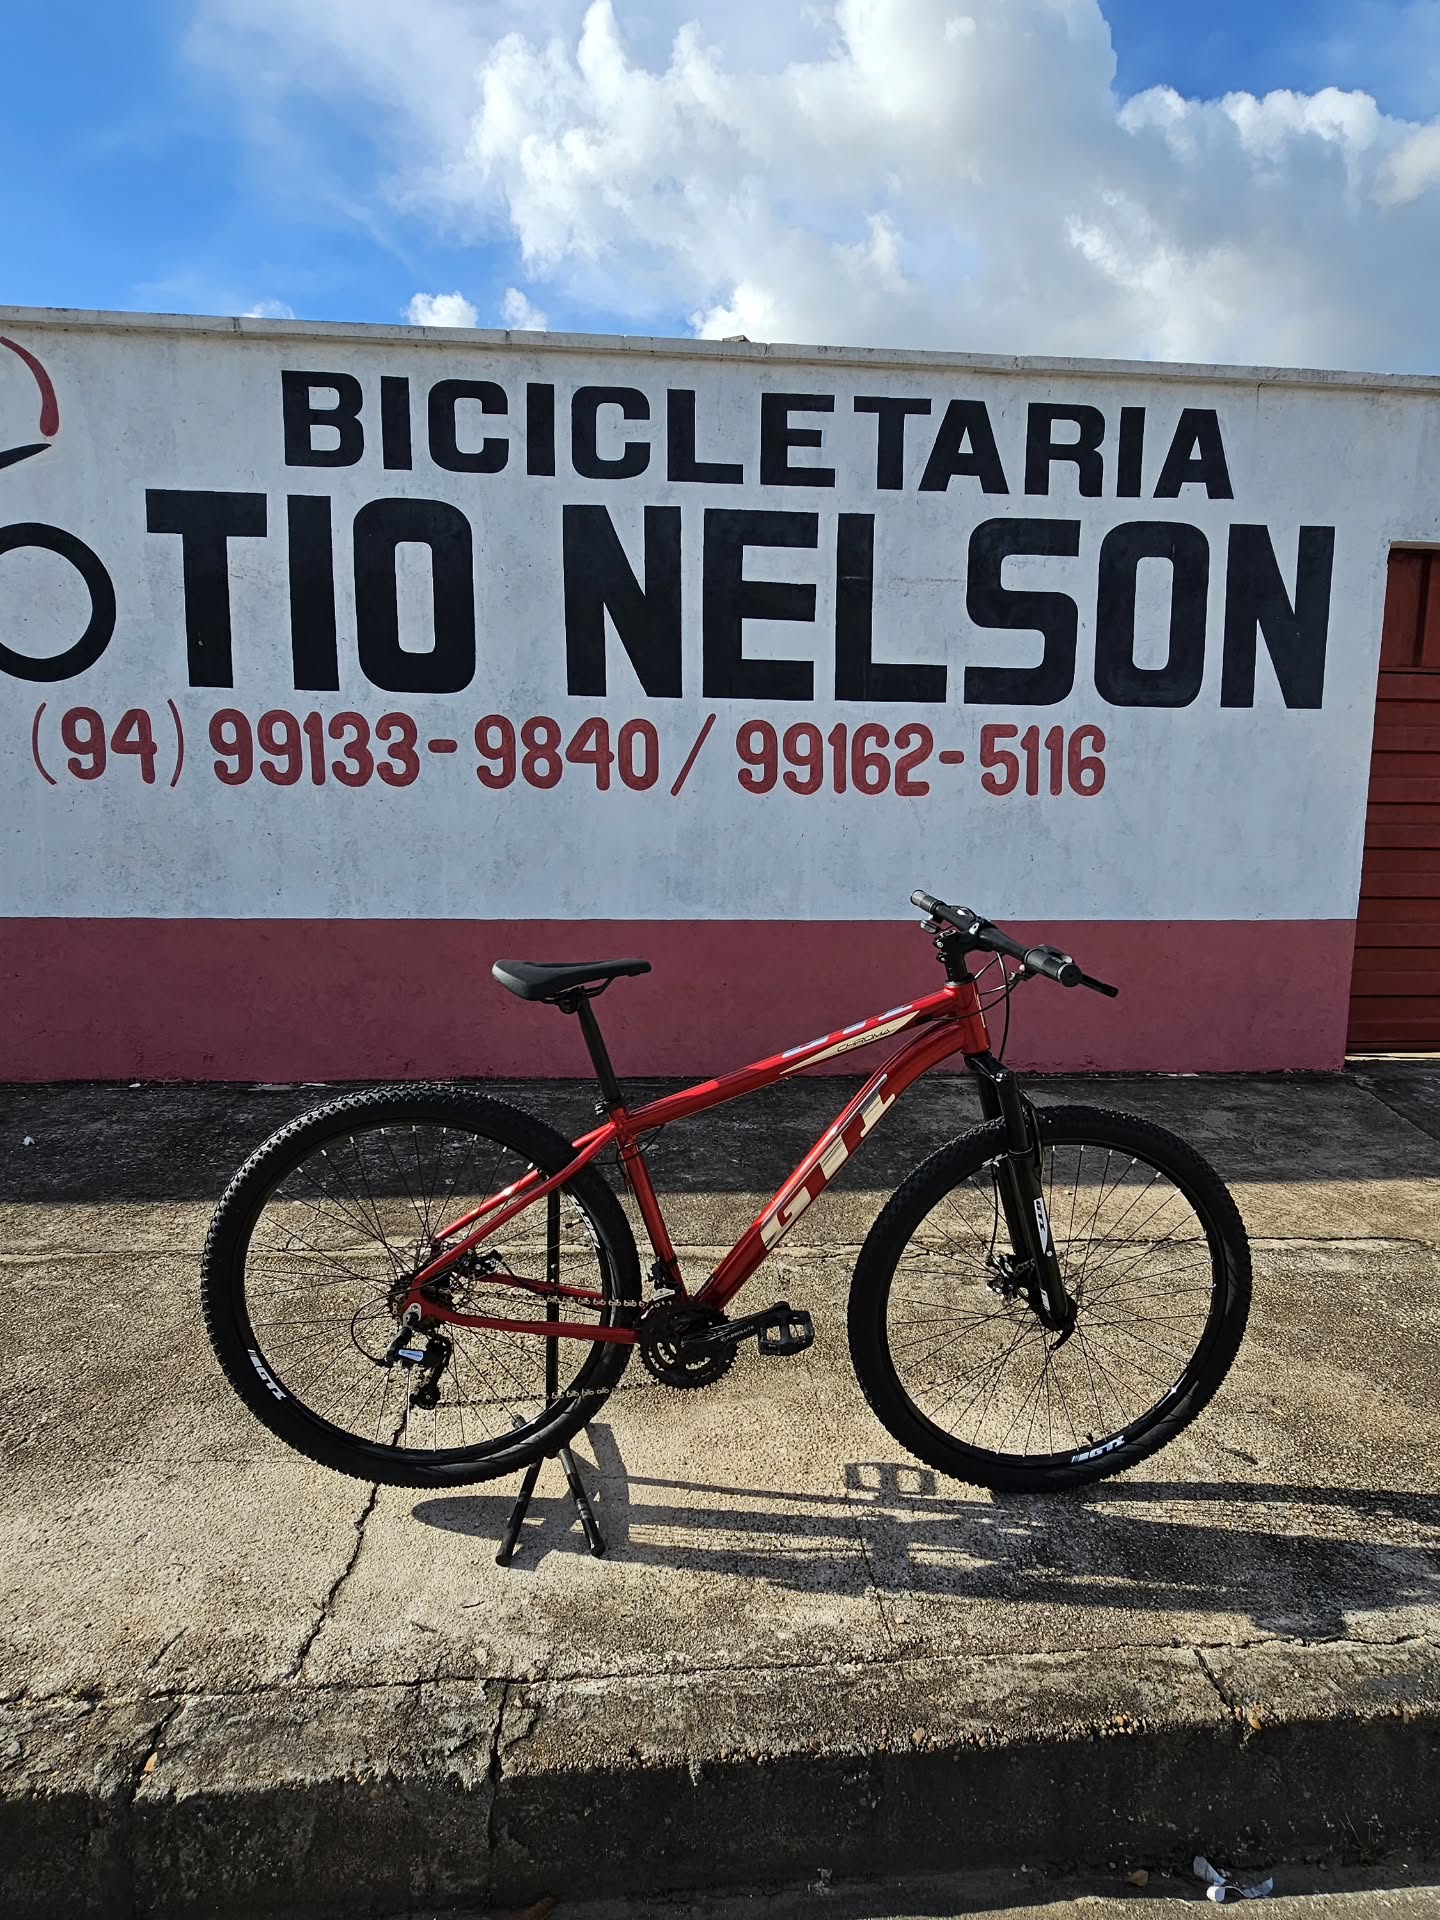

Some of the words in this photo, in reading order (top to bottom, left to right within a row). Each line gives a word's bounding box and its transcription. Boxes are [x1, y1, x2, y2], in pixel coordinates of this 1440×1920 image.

[281, 369, 1235, 500] BICICLETARIA
[146, 488, 477, 694] TIO
[562, 504, 1336, 710] NELSON
[32, 698, 184, 787] (94)
